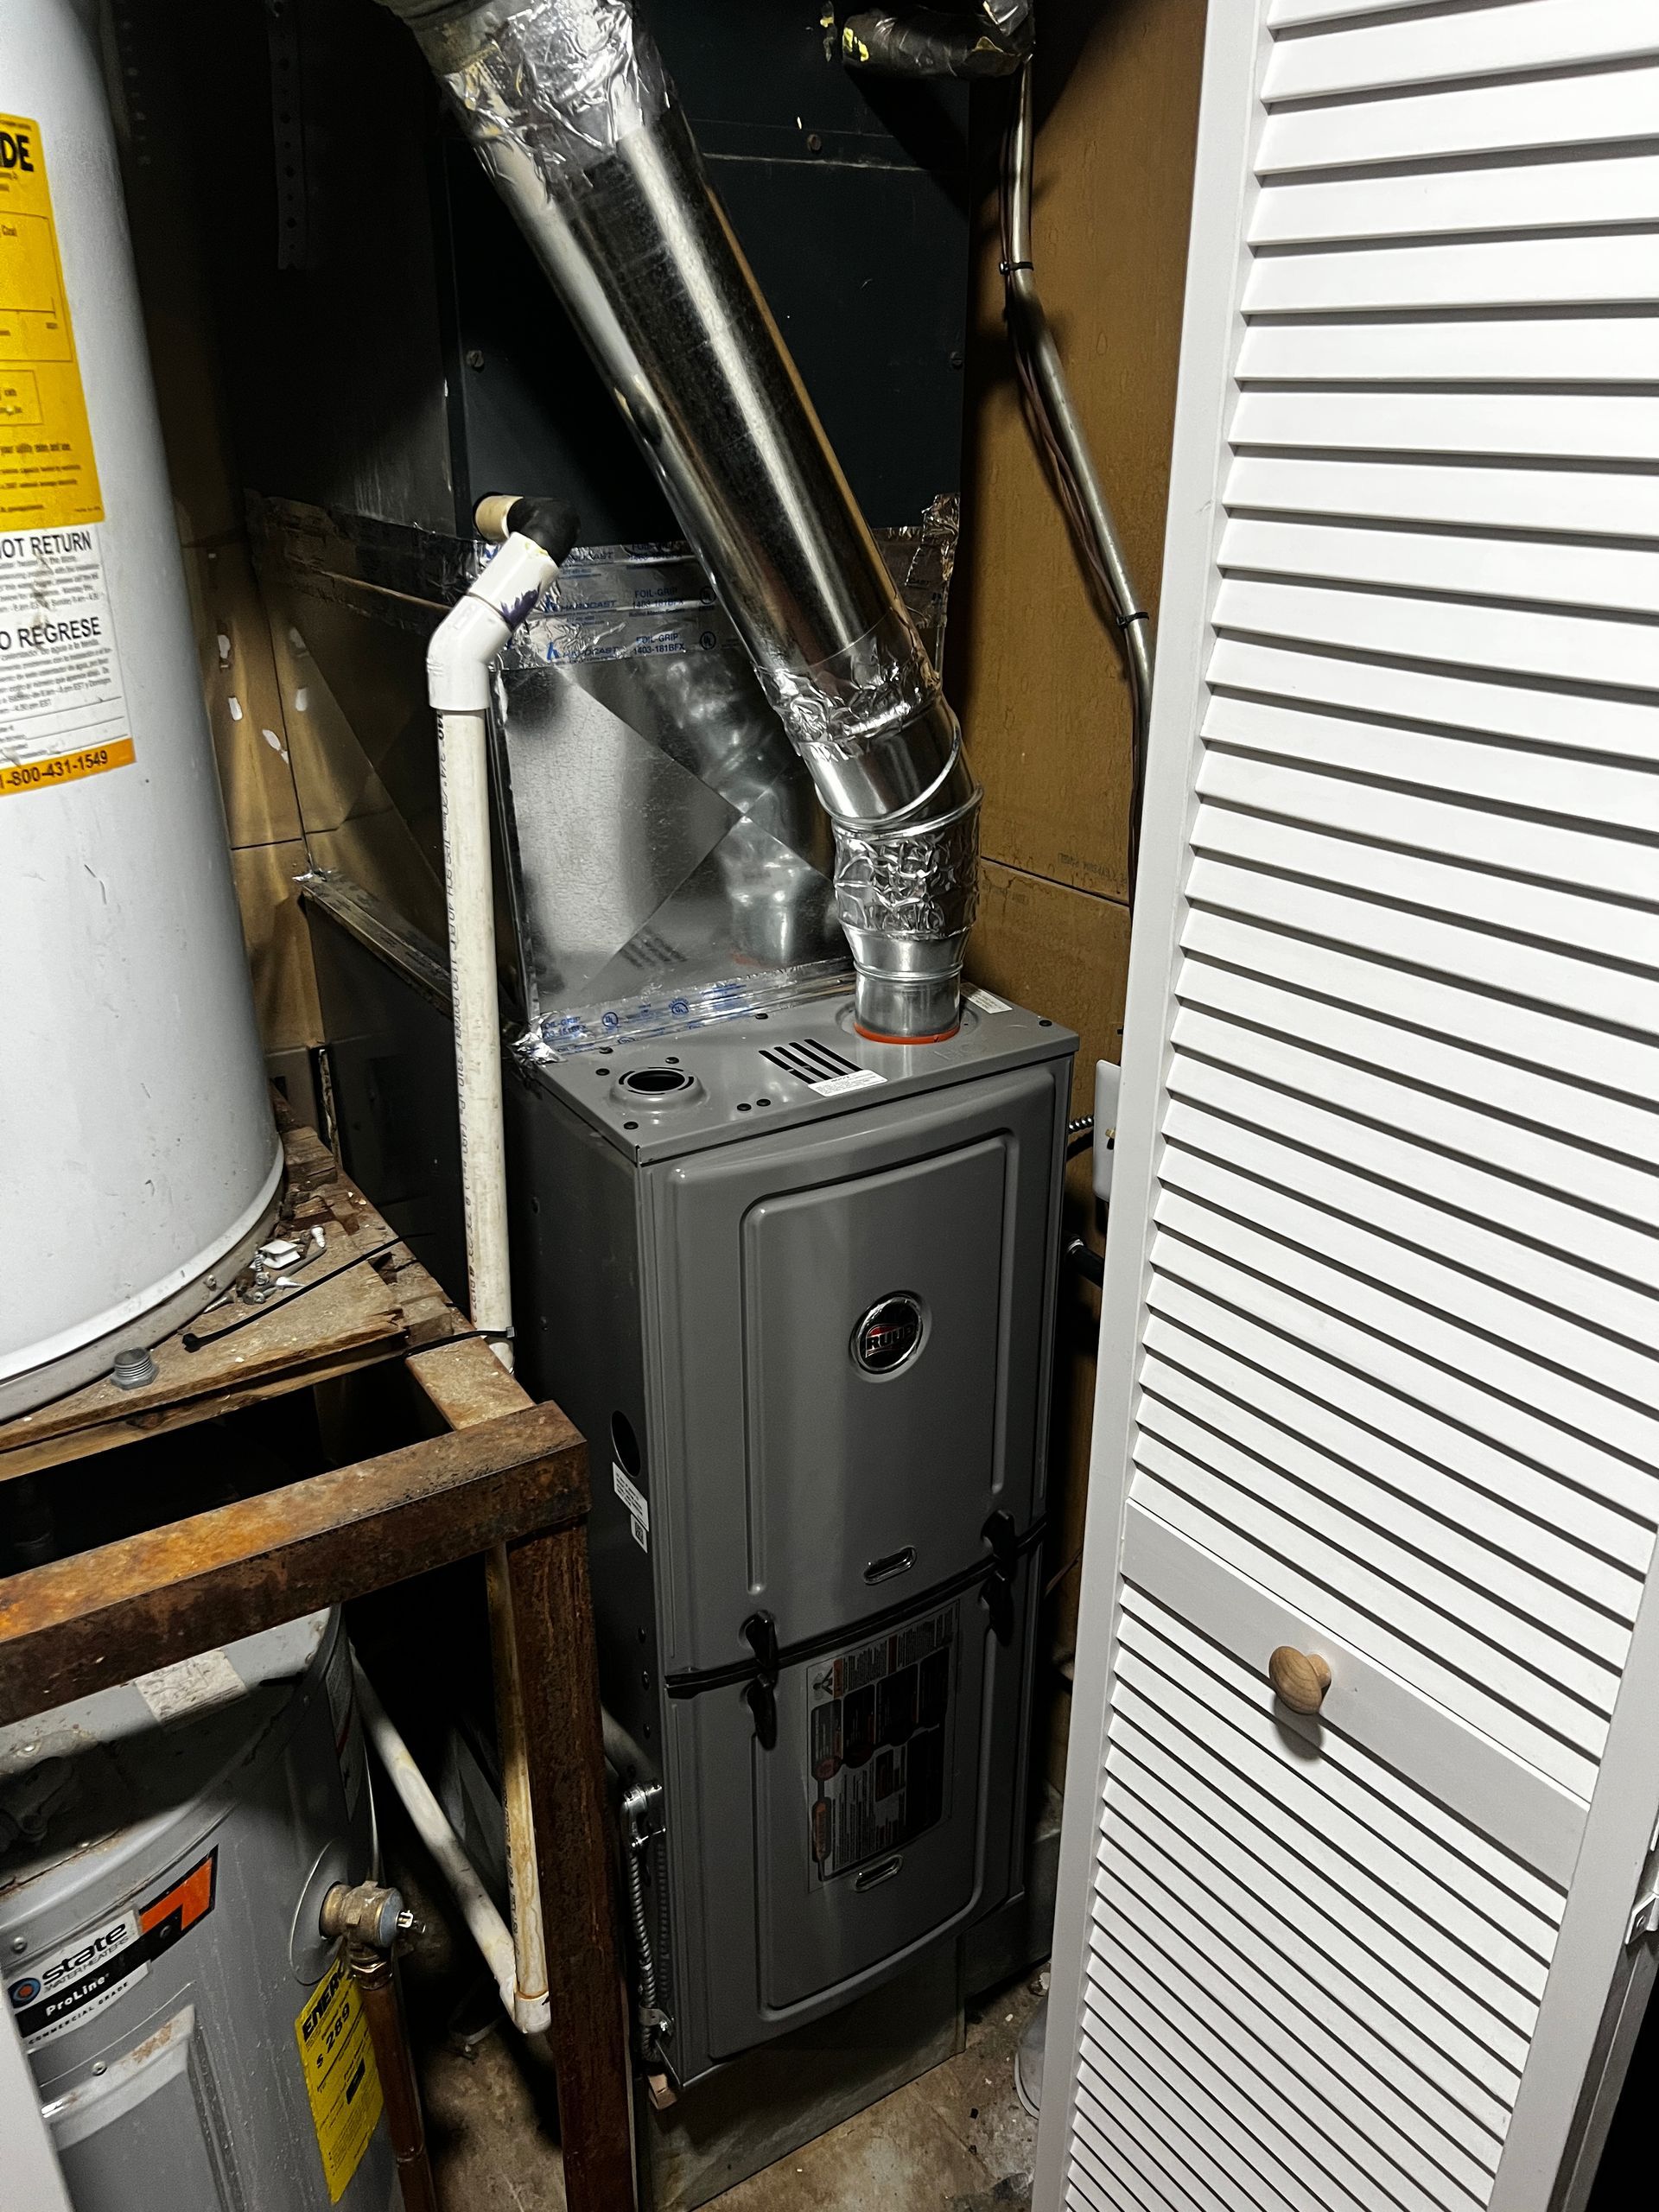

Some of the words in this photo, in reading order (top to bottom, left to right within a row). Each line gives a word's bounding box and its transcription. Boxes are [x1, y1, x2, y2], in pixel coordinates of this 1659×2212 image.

[0, 537, 24, 559] OT
[30, 531, 92, 556] RETURN
[17, 617, 102, 648] REGRESE
[633, 643, 685, 655] 1403-181BFX
[636, 632, 678, 645] FOIL-GRIP
[42, 1923, 127, 1986] state
[83, 1936, 130, 1969] HEATERS
[29, 2005, 94, 2044] COMMERCIAL
[99, 1980, 128, 2005] GRADE
[46, 1975, 105, 2016] ProLine
[326, 2002, 350, 2054] 289
